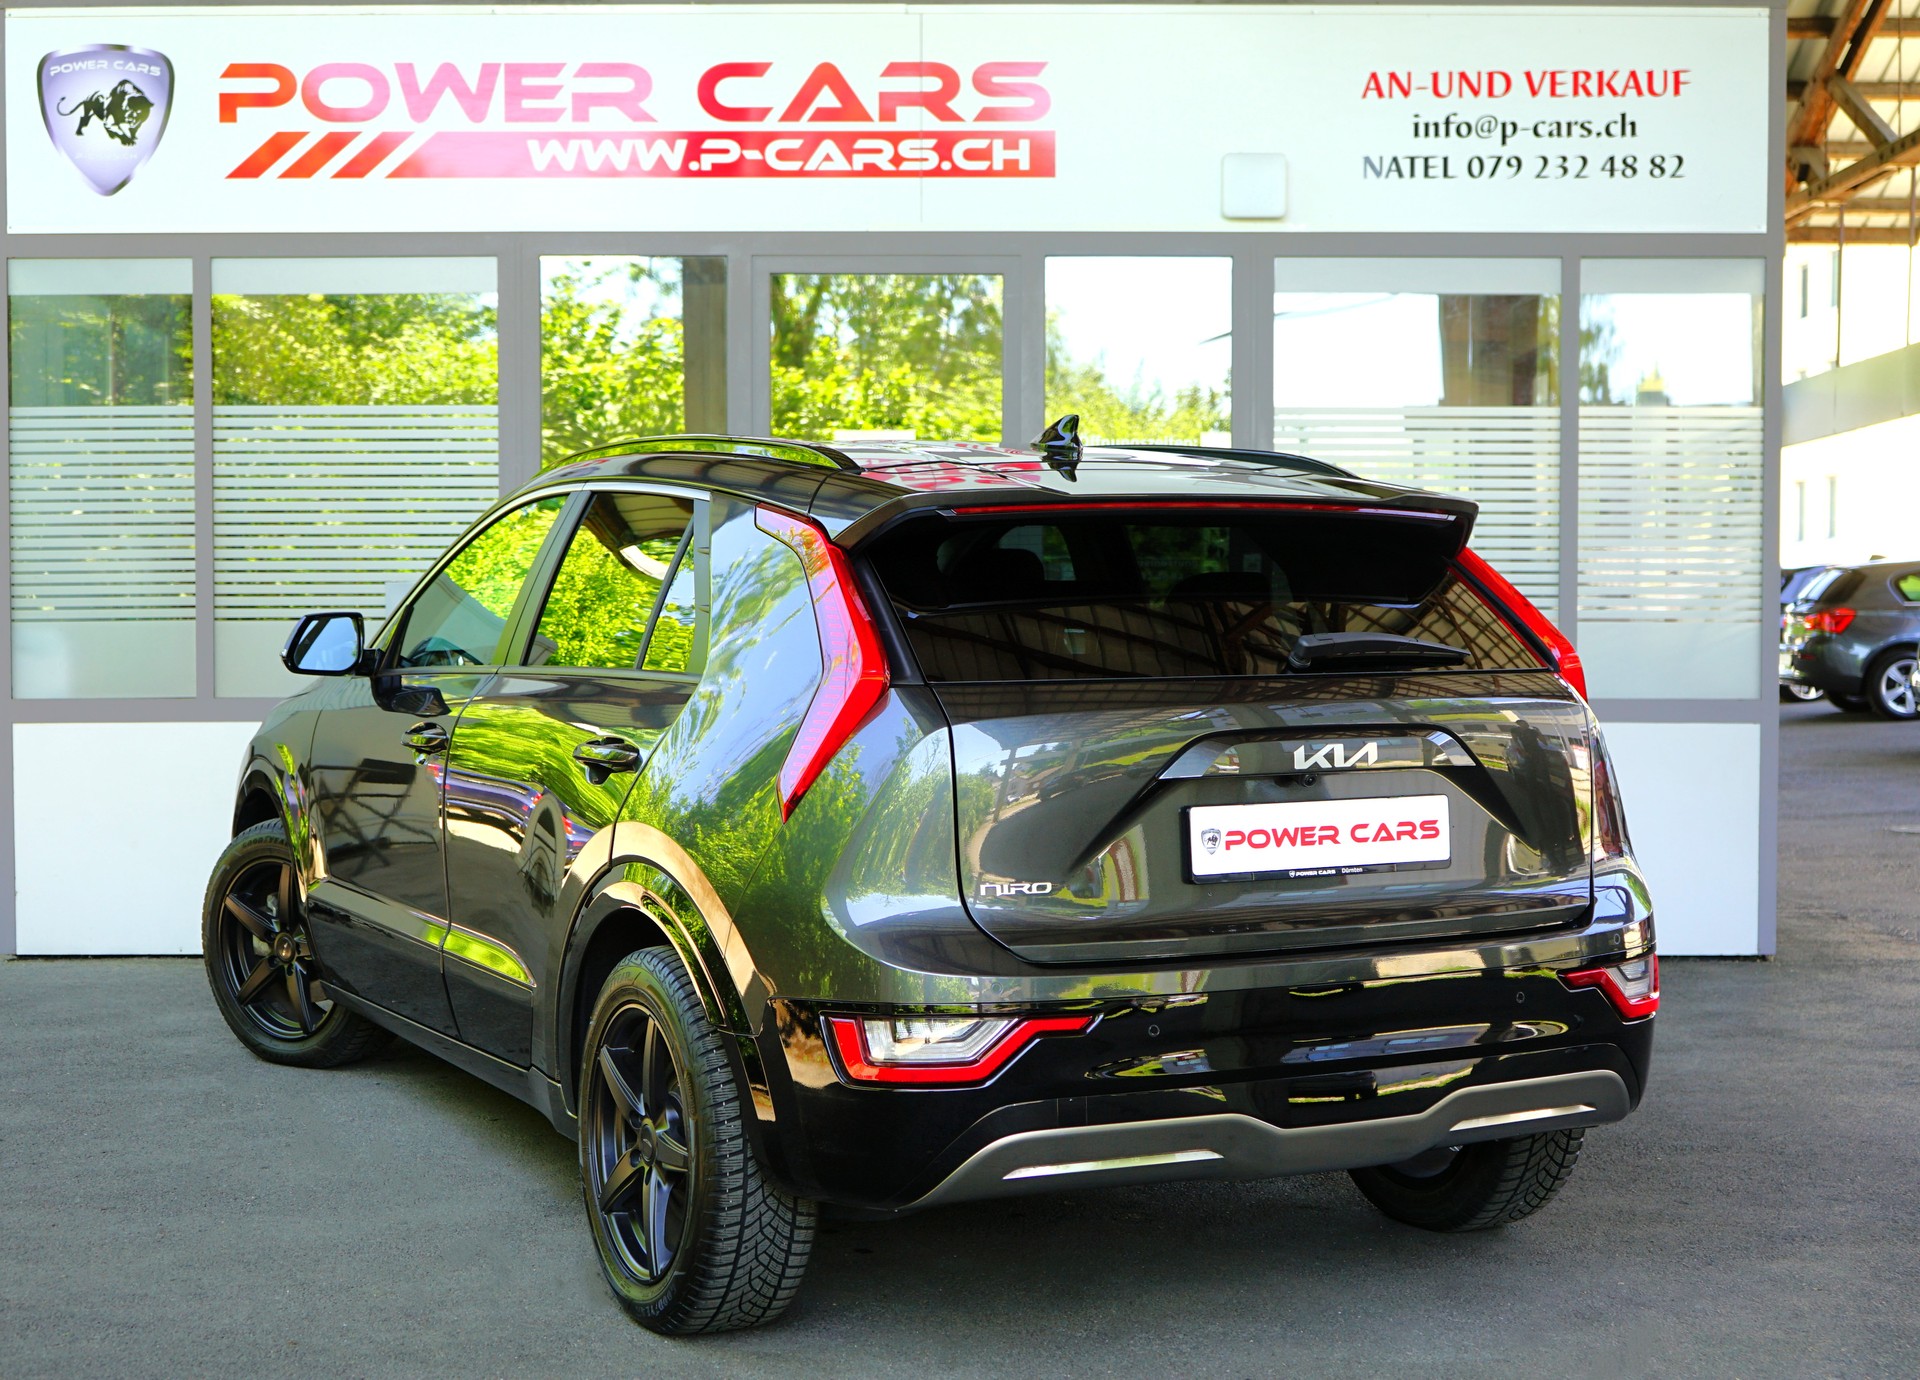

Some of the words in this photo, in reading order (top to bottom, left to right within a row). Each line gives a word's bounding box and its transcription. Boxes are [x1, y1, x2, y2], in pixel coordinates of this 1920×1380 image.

[50, 60, 108, 76] POWER
[113, 60, 161, 76] CARS
[219, 62, 658, 123] POWER
[697, 61, 1052, 122] CARS
[1361, 70, 1513, 99] AN-UND
[1524, 69, 1692, 98] VERKAUF
[1412, 112, 1638, 147] info@p-cars.ch
[526, 138, 1031, 172] WWW.P-CARS.CH
[1363, 155, 1458, 179] NATEL
[1467, 155, 1523, 179] 079
[1535, 155, 1590, 179] 232
[1601, 155, 1638, 179] 48
[1649, 155, 1687, 179] 82
[1293, 741, 1379, 770] KIA
[1225, 825, 1341, 851] POWER
[1350, 819, 1441, 843] CARS
[980, 882, 1052, 896] NIRO
